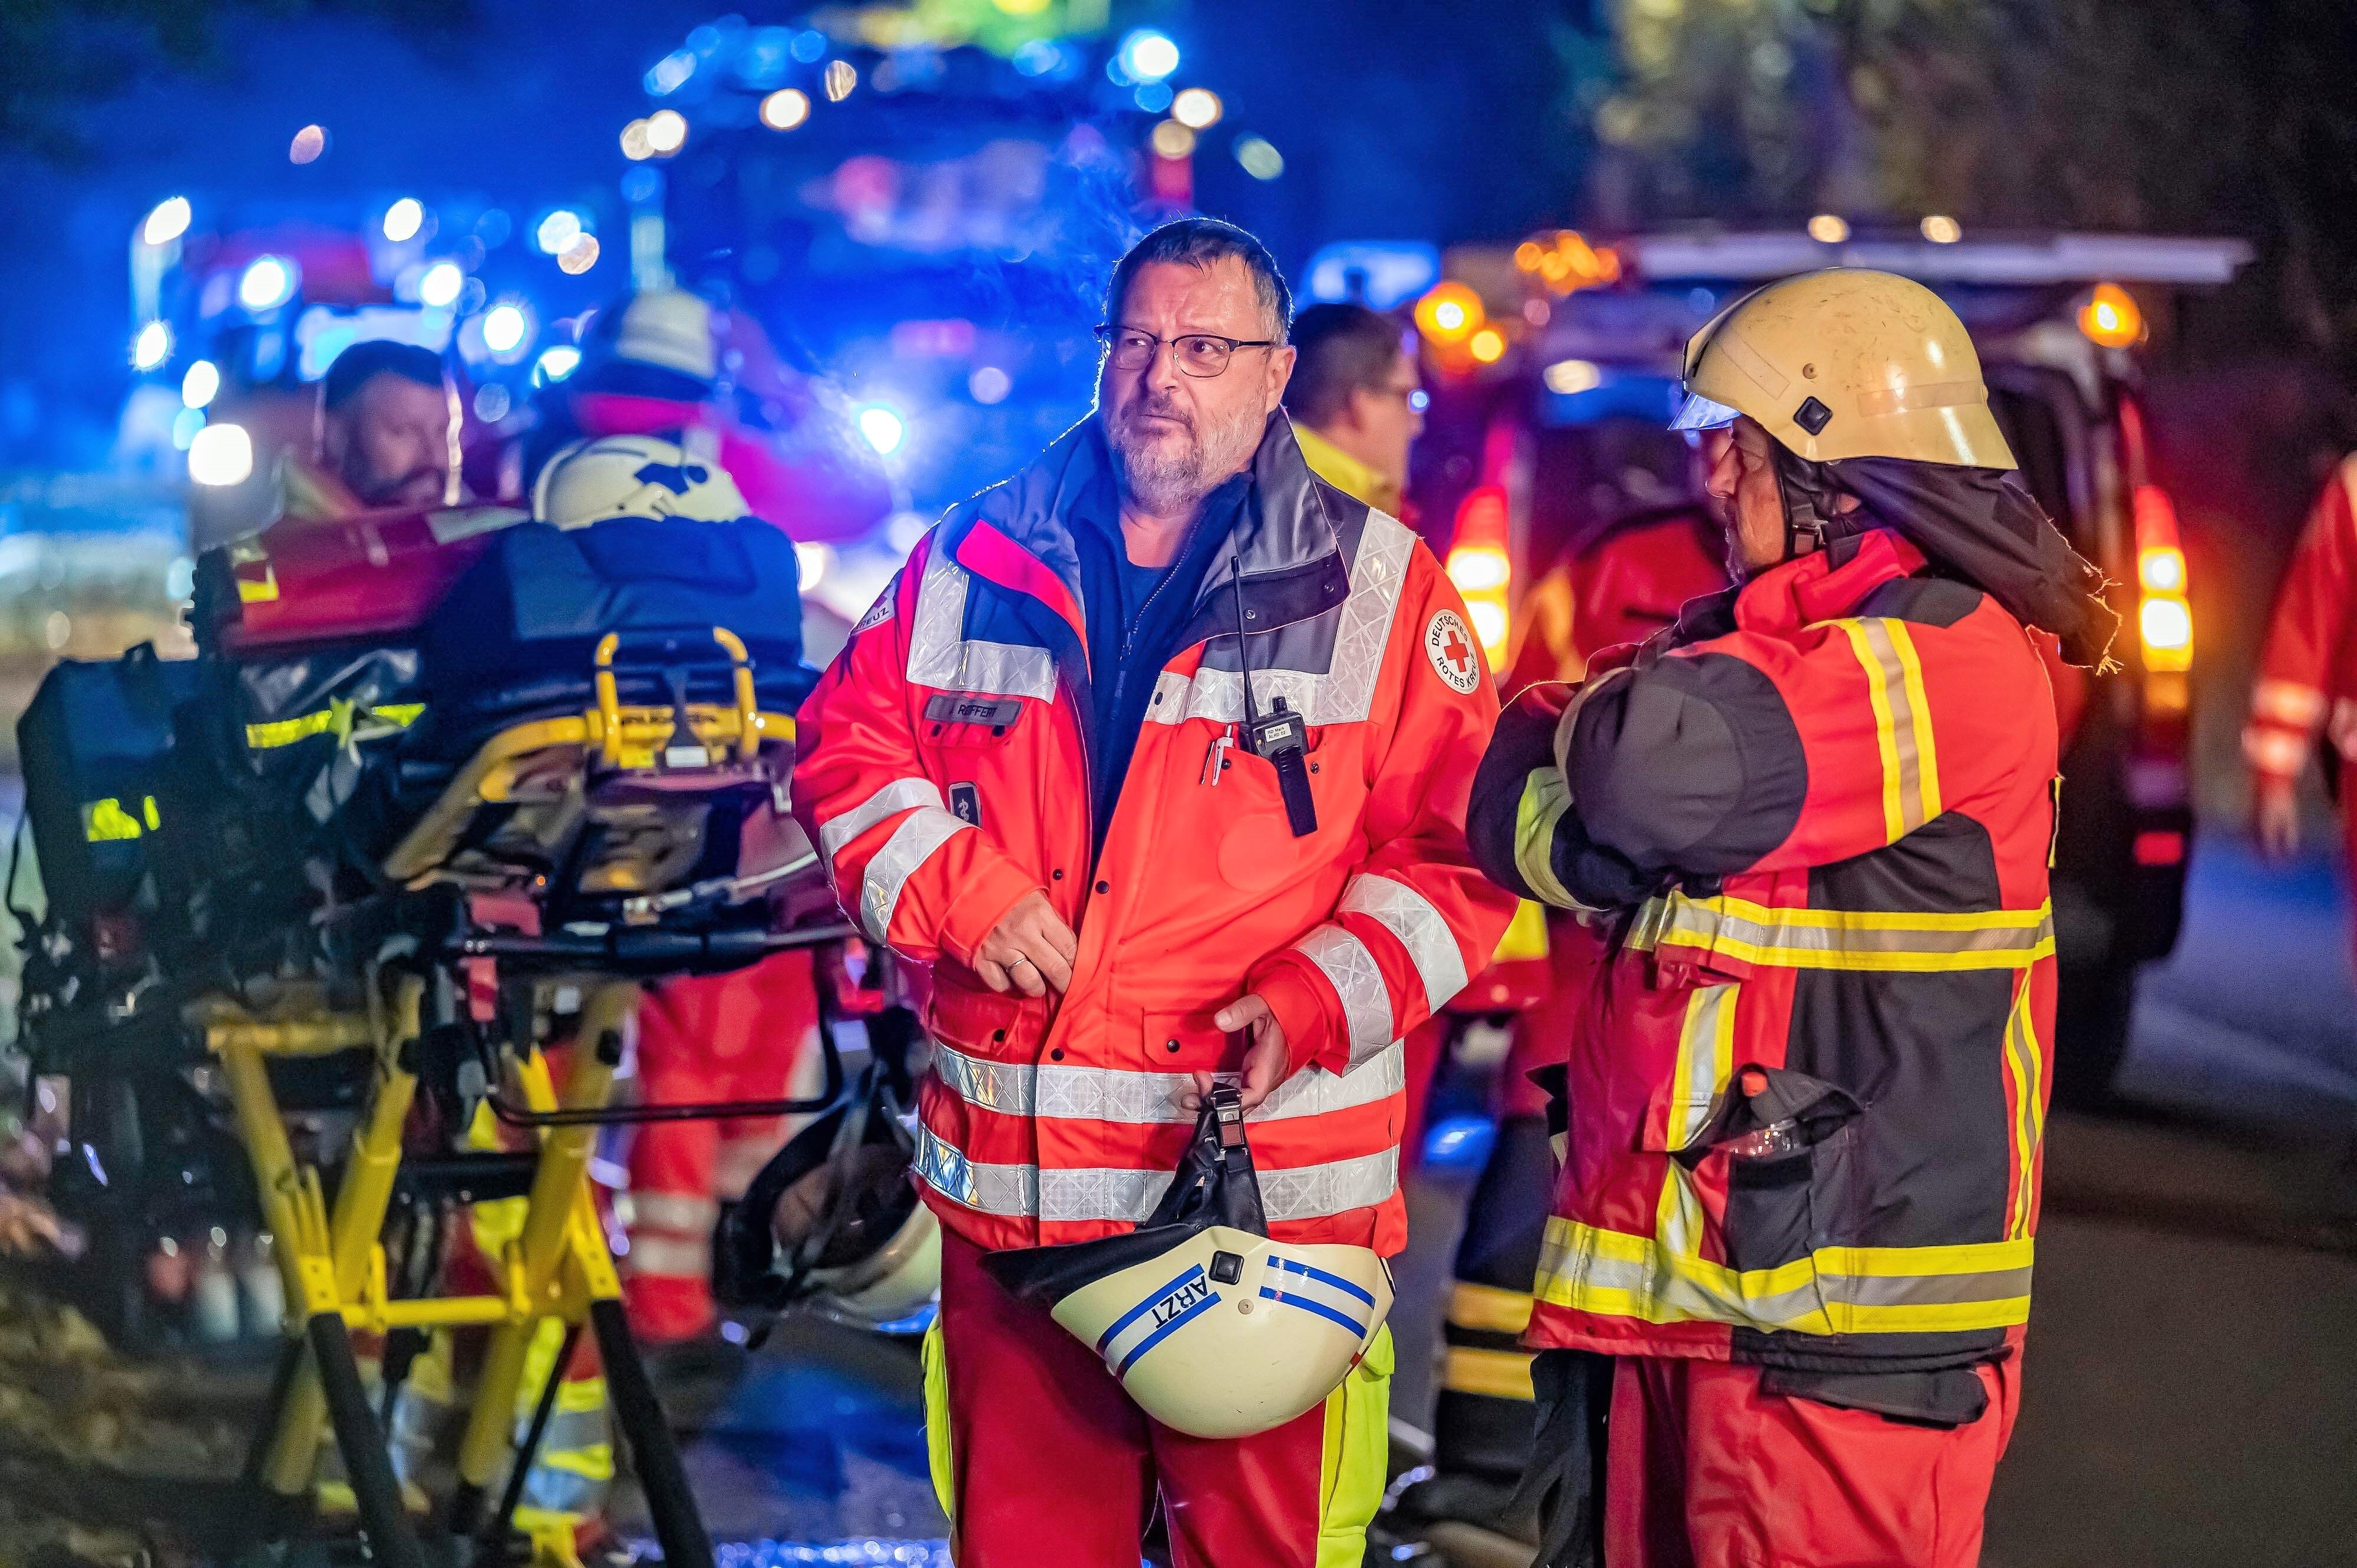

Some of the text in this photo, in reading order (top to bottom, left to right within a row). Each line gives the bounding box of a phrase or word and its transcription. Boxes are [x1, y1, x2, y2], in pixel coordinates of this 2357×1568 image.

[1432, 615, 1468, 647] DEUTSCHES
[1437, 656, 1465, 688] ROTES
[1151, 1275, 1208, 1329] ARZT
